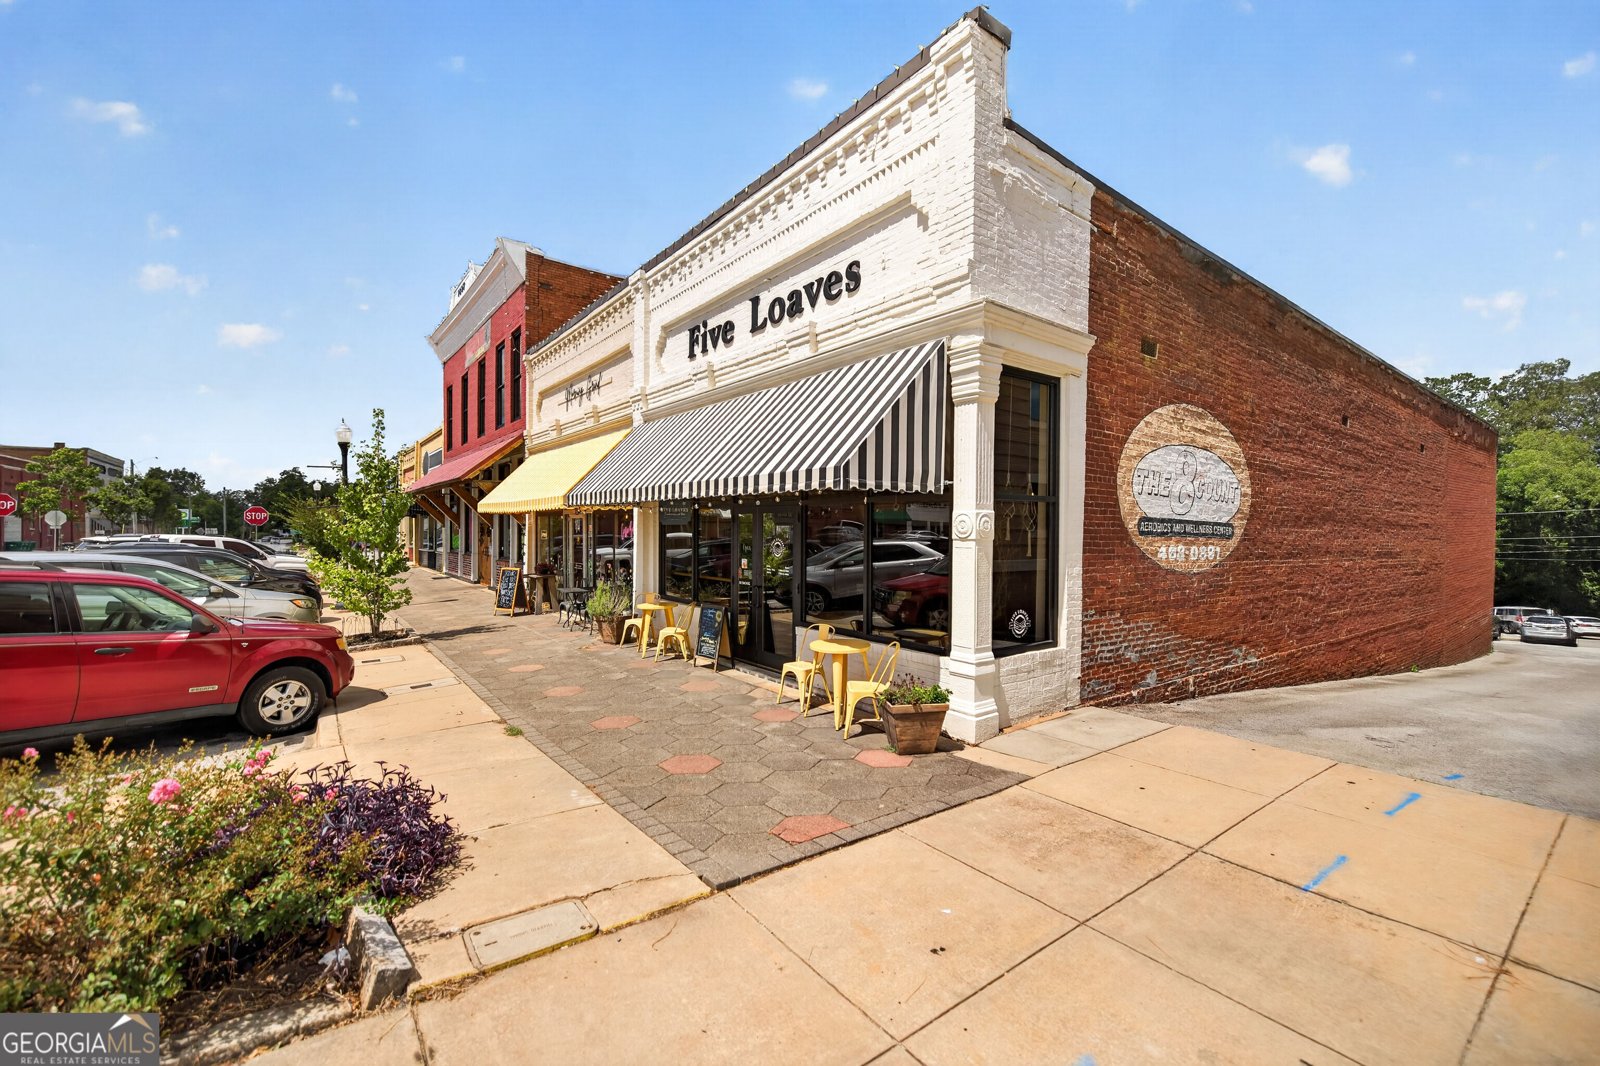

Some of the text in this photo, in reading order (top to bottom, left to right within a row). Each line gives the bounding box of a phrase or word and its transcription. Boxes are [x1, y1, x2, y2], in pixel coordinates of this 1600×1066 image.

[688, 260, 861, 359] Five Loaves
[1137, 450, 1239, 515] THE 8 COUNT
[246, 512, 267, 520] STOP
[1140, 522, 1232, 535] AEROBICS AND WELLNESS CENTER
